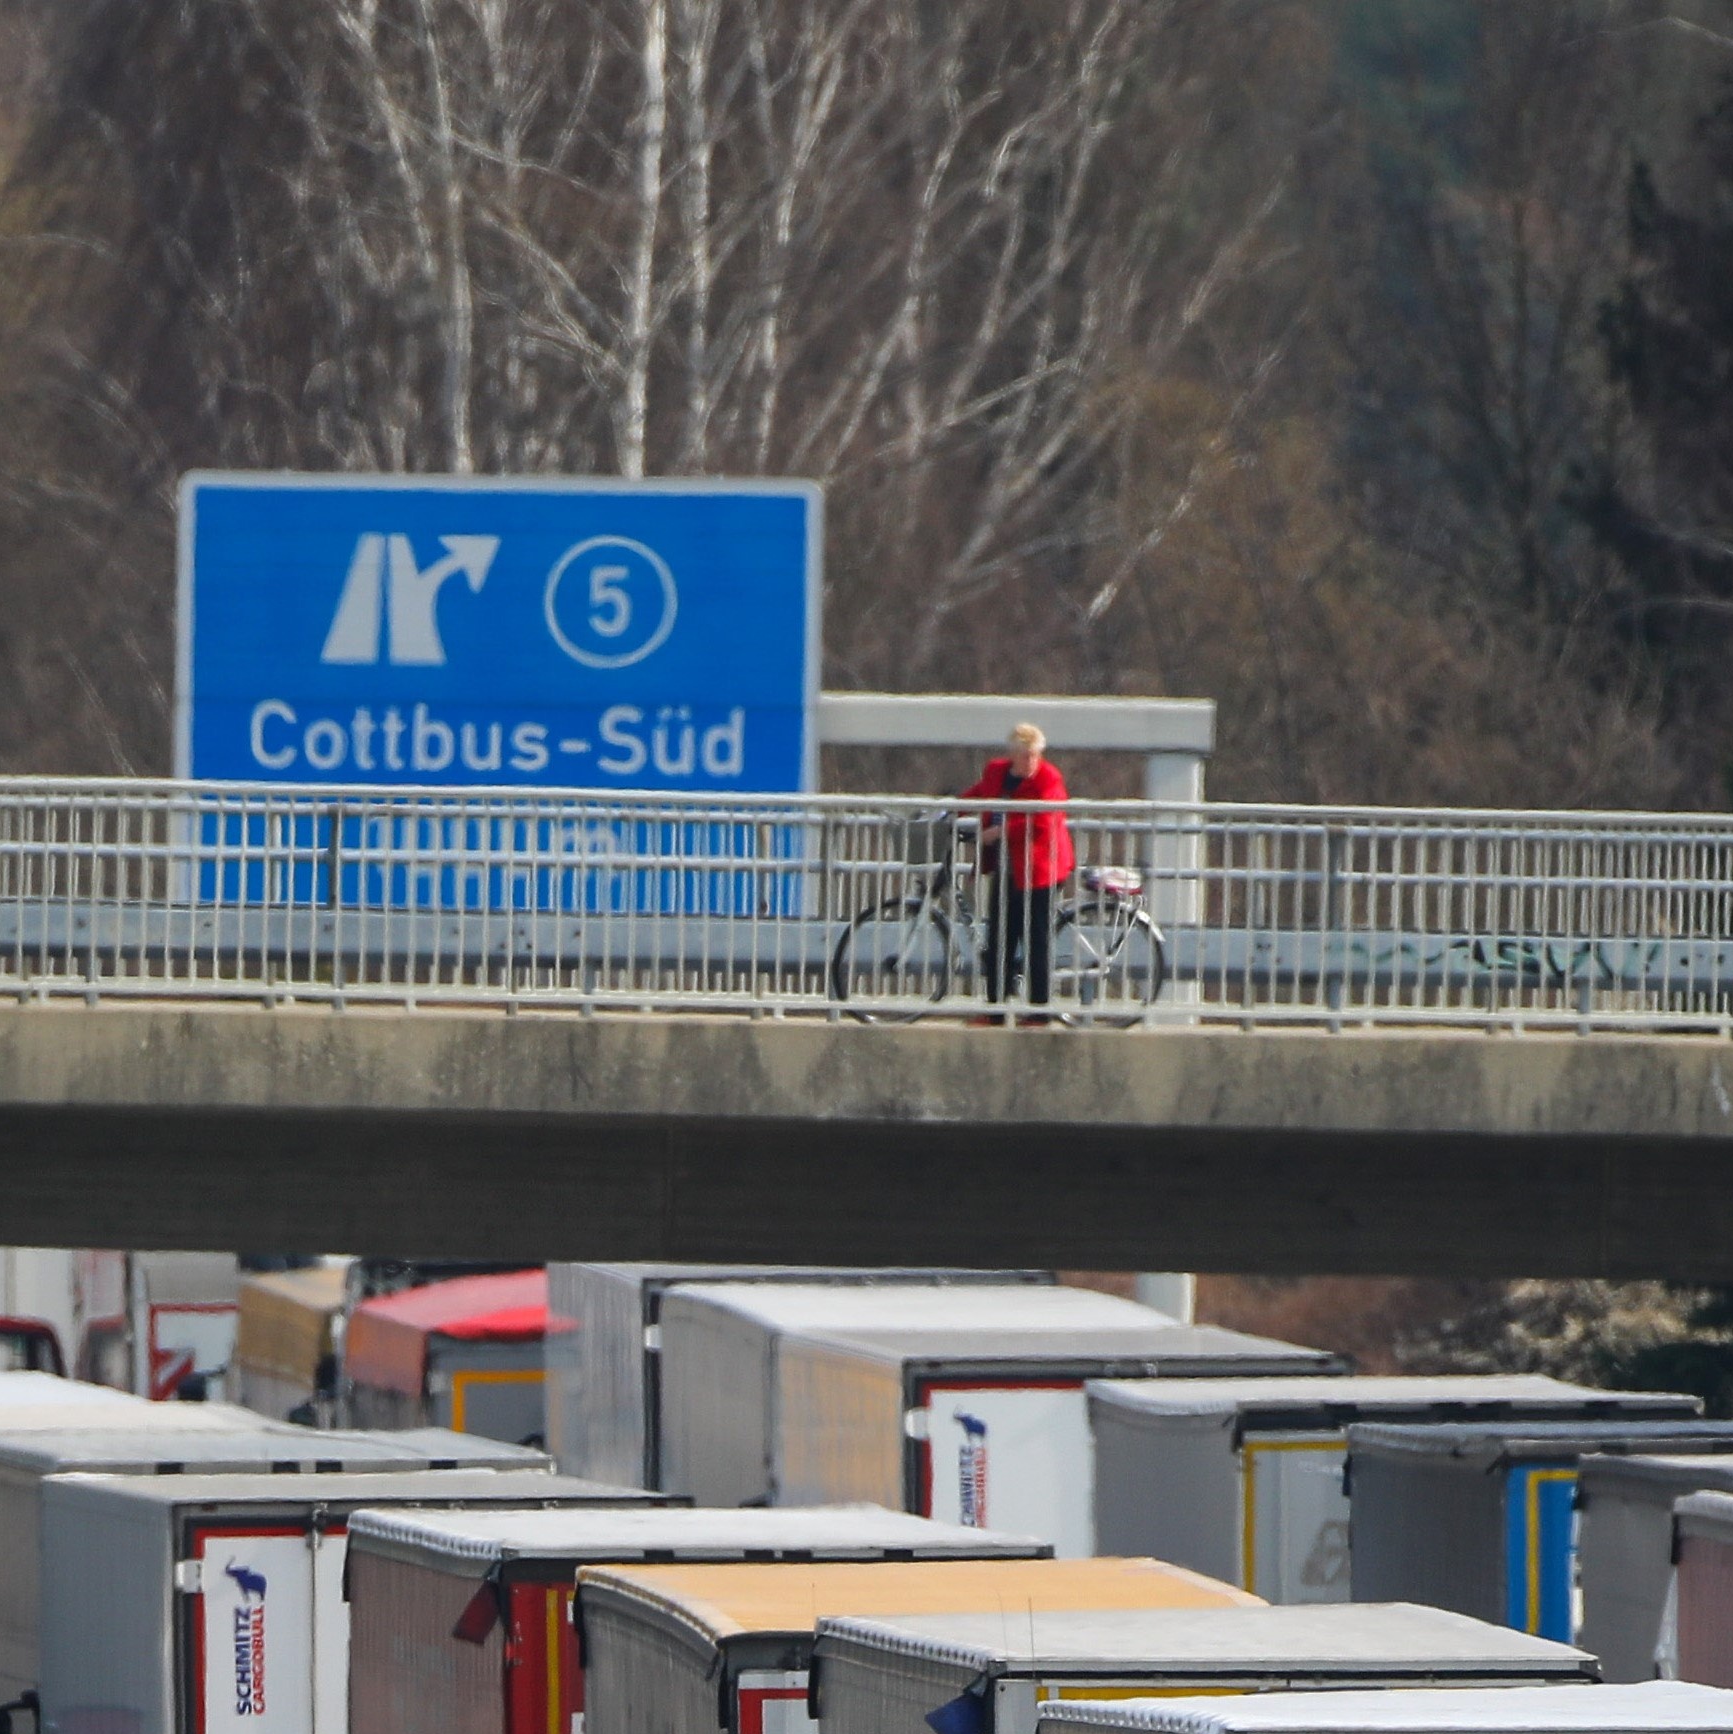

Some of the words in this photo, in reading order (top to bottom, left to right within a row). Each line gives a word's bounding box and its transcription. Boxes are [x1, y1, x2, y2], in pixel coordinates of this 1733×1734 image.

[587, 565, 633, 638] 5
[249, 699, 747, 778] Cottbus-Süd
[234, 1606, 252, 1716] SCHMITZ
[252, 1605, 265, 1716] CARGOBULL
